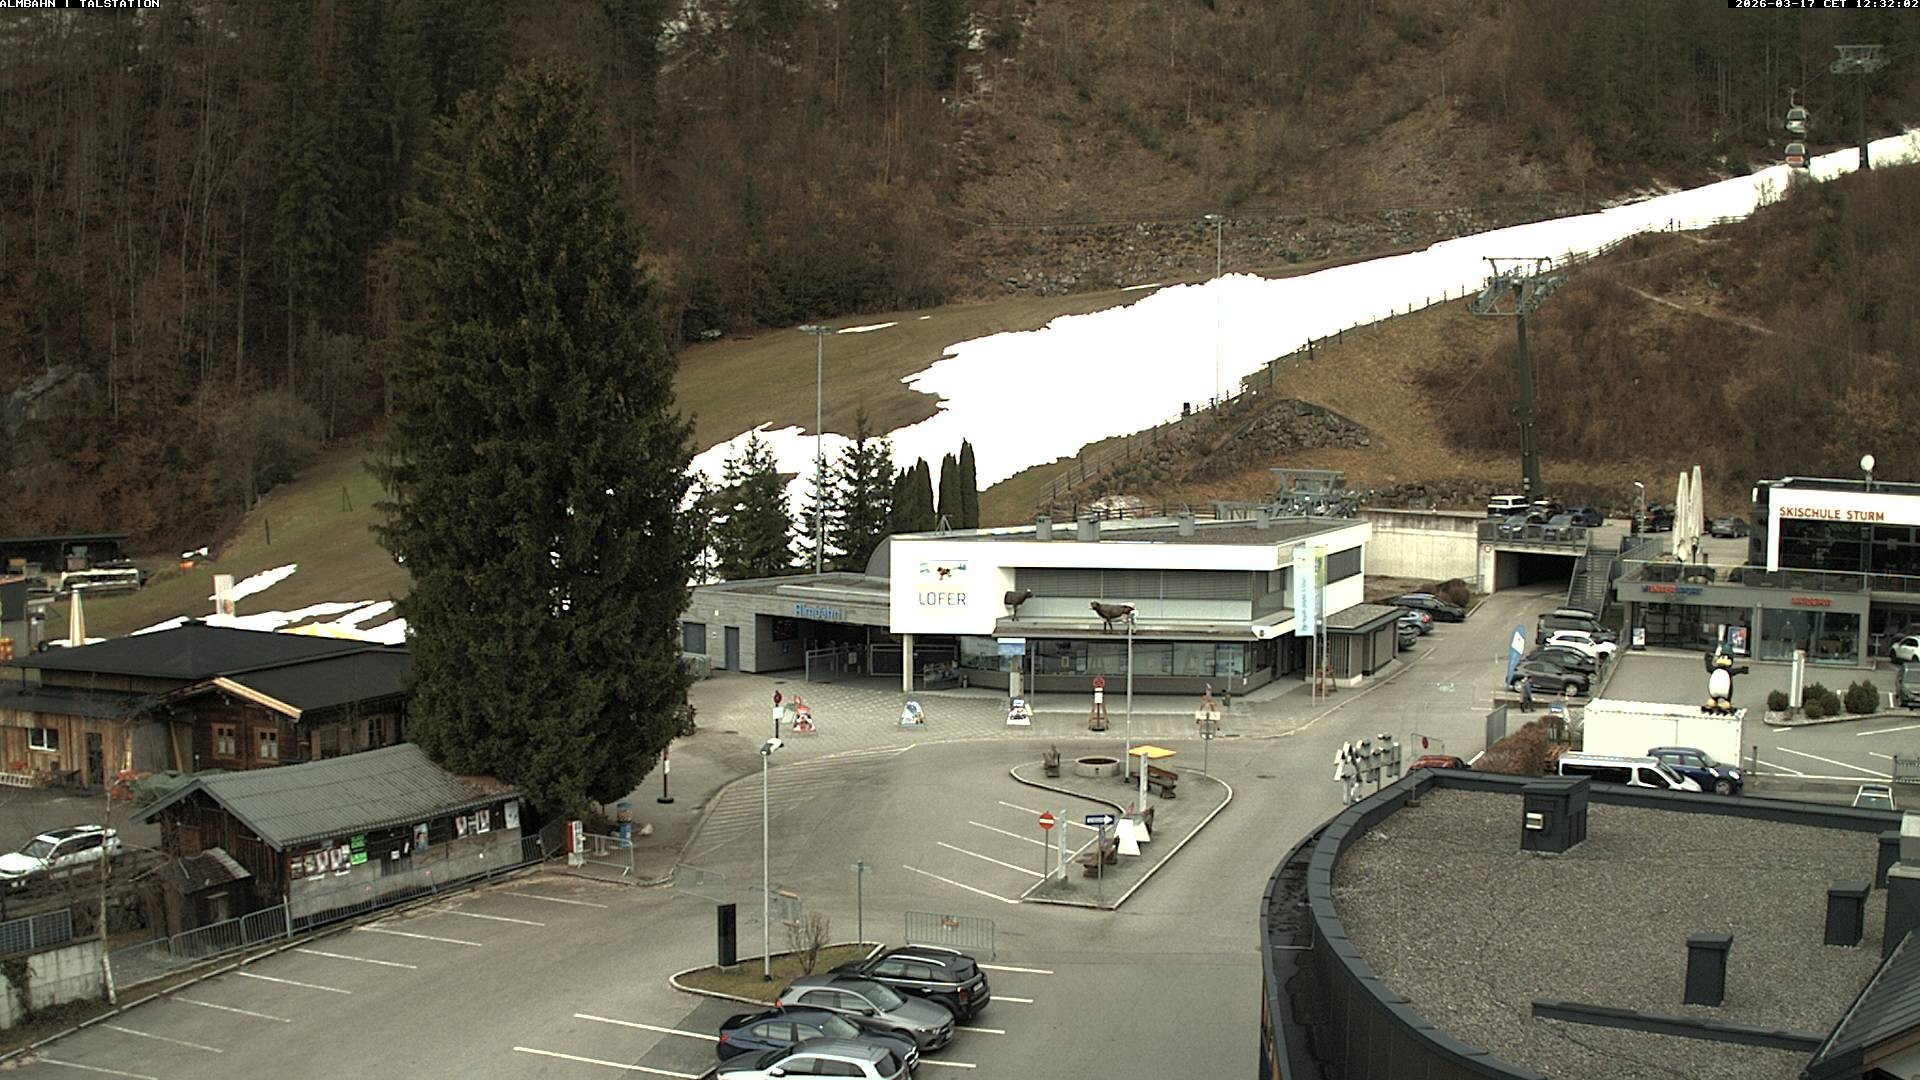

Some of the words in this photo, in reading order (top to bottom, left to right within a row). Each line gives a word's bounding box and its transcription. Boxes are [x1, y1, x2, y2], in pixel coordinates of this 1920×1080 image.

[1779, 506, 1841, 519] SKISCHULE
[1846, 510, 1885, 521] STURM
[918, 591, 967, 606] LOFER
